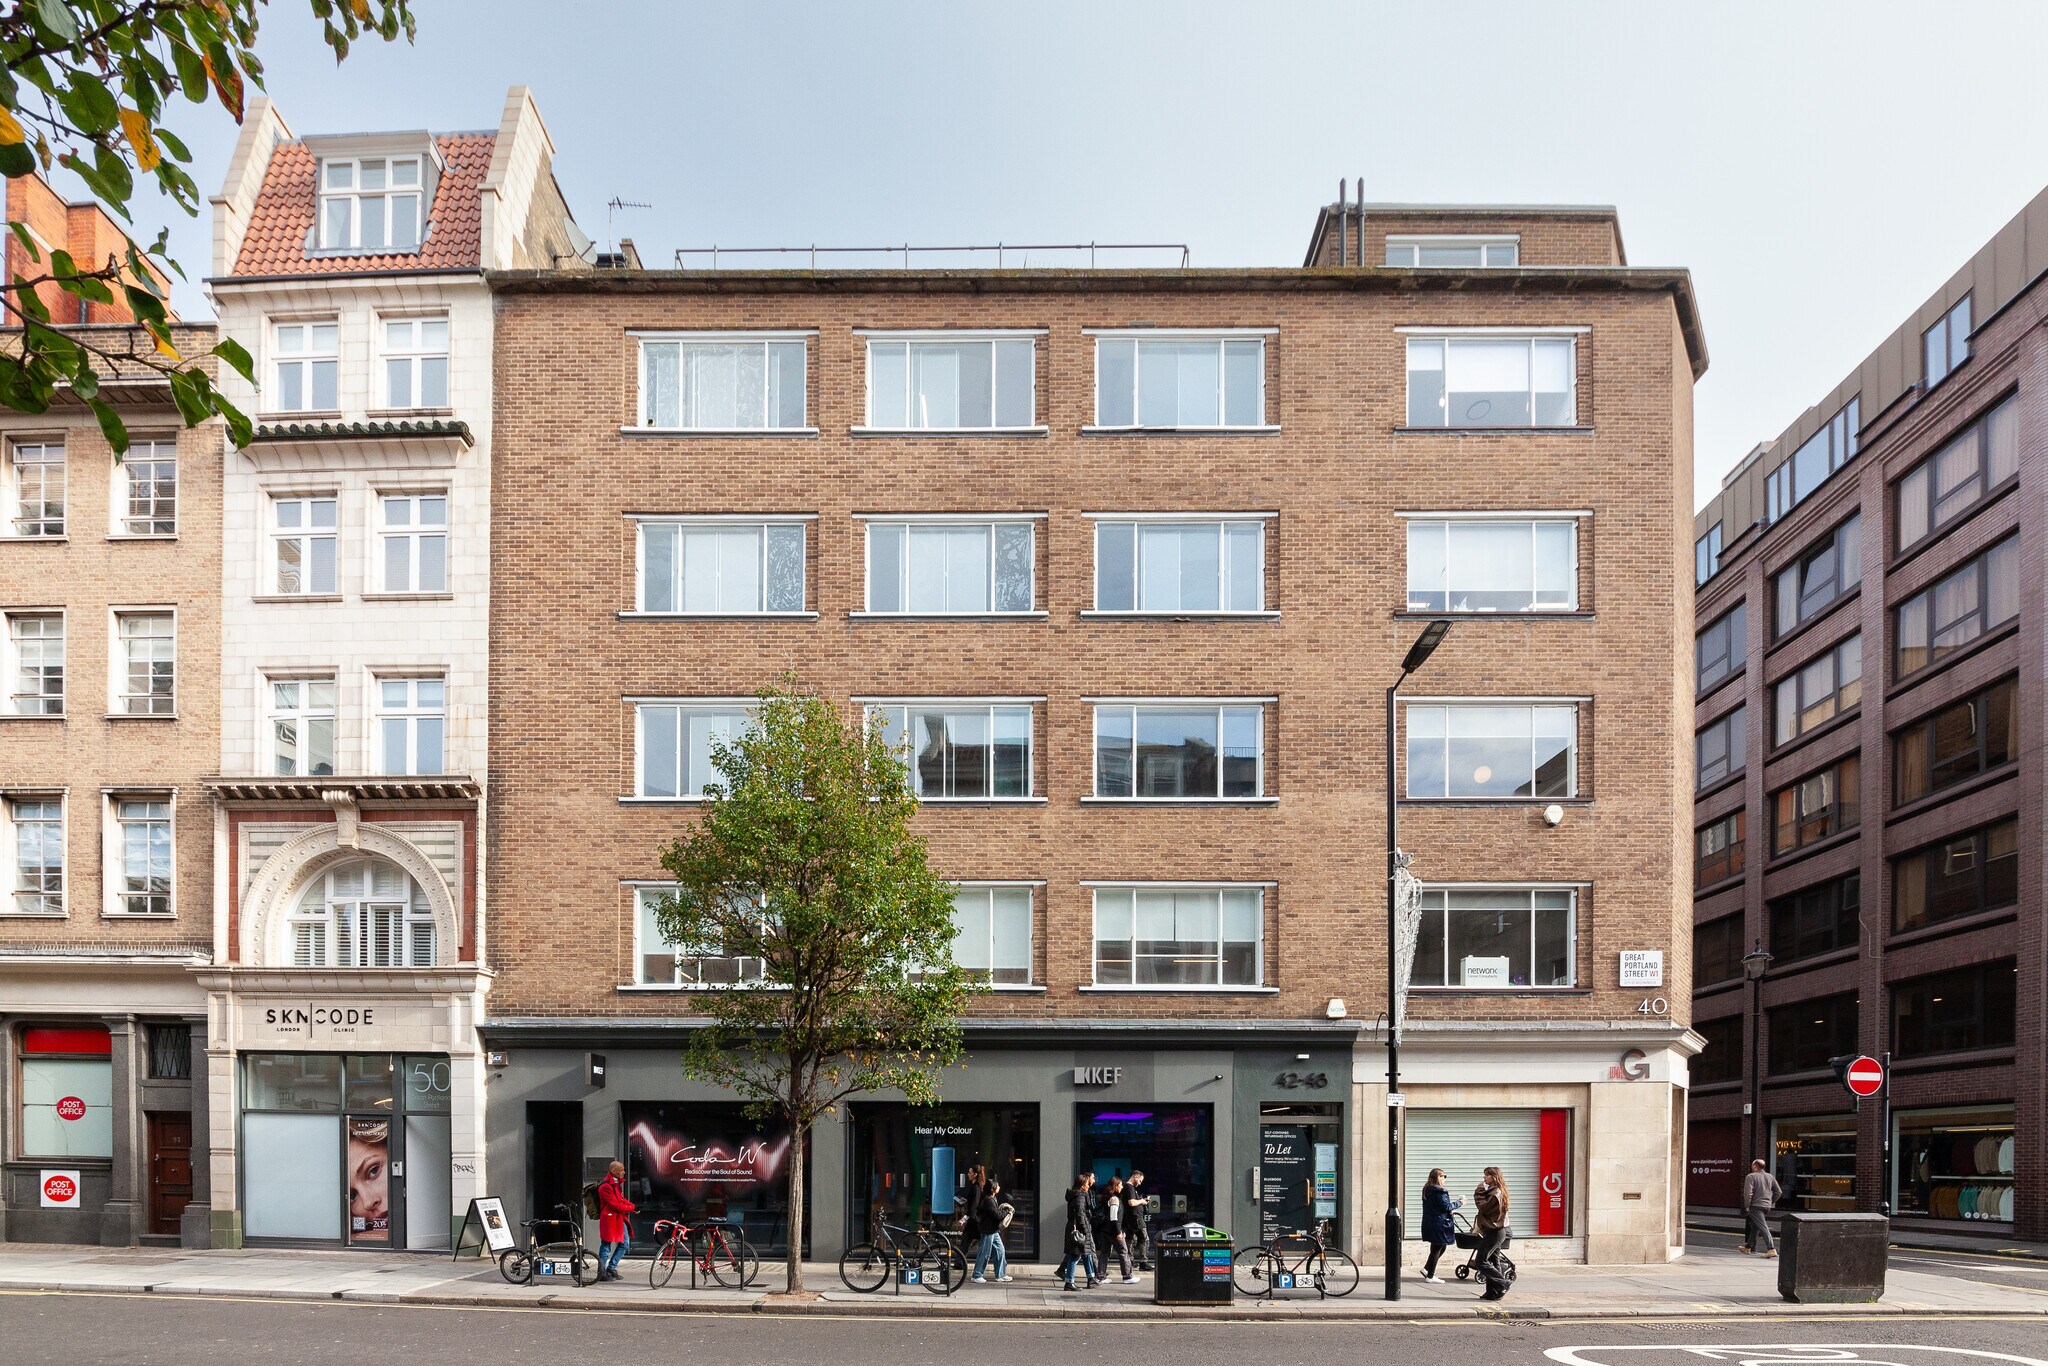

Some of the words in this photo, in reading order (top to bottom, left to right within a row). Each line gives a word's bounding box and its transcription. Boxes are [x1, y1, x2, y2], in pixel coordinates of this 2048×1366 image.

[1624, 953, 1645, 961] GREAT
[1624, 962, 1658, 970] PORTLAND
[1624, 970, 1648, 978] STREET
[1649, 970, 1659, 978] W1
[1638, 997, 1668, 1015] 40
[414, 1062, 451, 1093] 50
[1273, 1072, 1329, 1089] 42-46
[914, 1126, 933, 1134] Hear
[934, 1126, 946, 1136] My
[947, 1126, 973, 1134] Colour
[670, 1145, 736, 1163] Coda
[737, 1142, 767, 1164] W
[1264, 1143, 1276, 1155] To
[1276, 1143, 1293, 1155] Let
[46, 1188, 73, 1196] OFFICE
[543, 1263, 551, 1275] P
[908, 1271, 917, 1283] P
[1281, 1275, 1291, 1287] P
